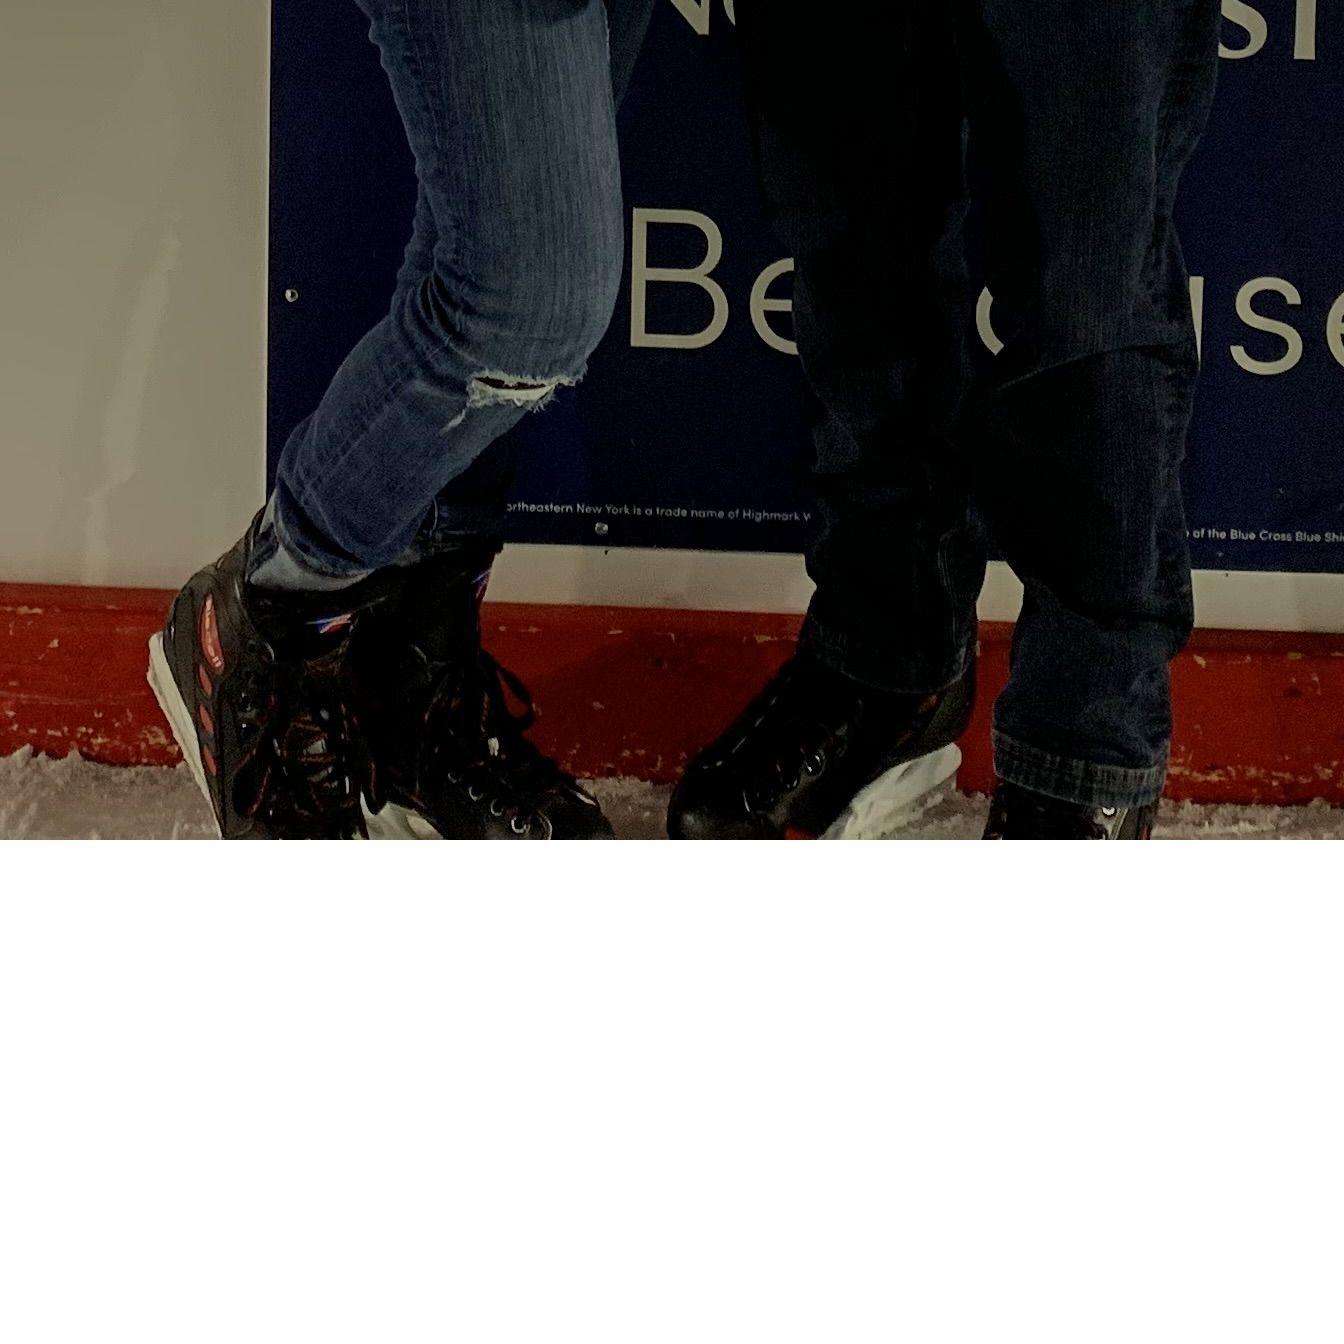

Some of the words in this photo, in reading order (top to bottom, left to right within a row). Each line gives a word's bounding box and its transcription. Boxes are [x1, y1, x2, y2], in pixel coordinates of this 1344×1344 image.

[576, 502, 603, 514] New
[605, 503, 631, 515] York
[632, 504, 642, 516] is
[644, 506, 653, 516] a
[656, 506, 688, 518] trade
[690, 509, 725, 519] name
[727, 508, 740, 519] of
[742, 508, 801, 523] Highmark
[1193, 528, 1205, 539] of
[1207, 528, 1227, 540] the
[1230, 529, 1256, 541] Blue
[1259, 530, 1293, 542] Cross
[1296, 531, 1321, 542] Blue
